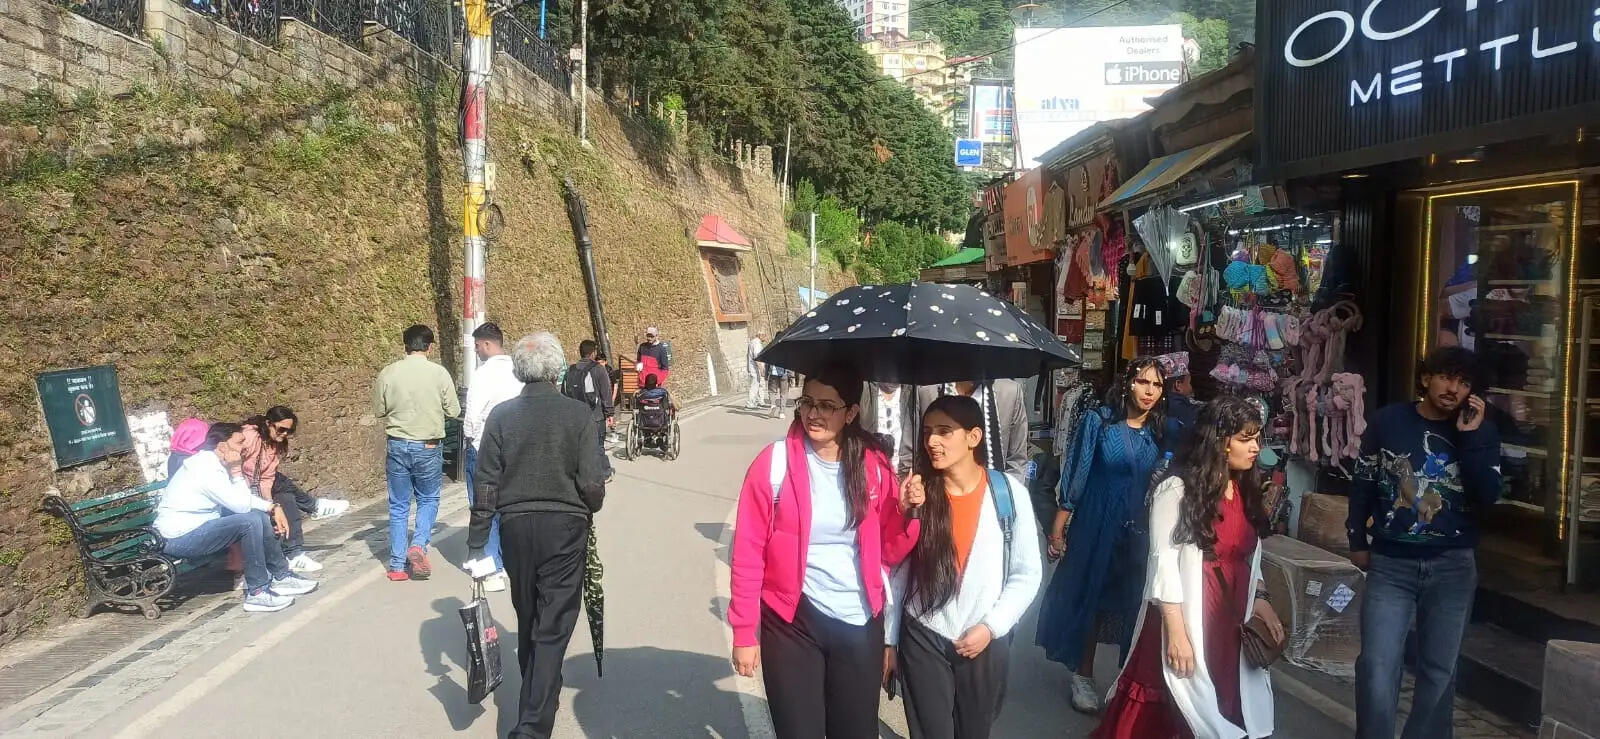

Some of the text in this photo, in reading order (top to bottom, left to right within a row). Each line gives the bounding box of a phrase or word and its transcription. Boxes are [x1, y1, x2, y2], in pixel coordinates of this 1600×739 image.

[1119, 35, 1168, 44] Authorised
[1284, 0, 1503, 67] OC
[1126, 47, 1161, 55] Dealers
[1351, 8, 1600, 107] METTL
[1125, 65, 1180, 81] iPhone
[960, 148, 980, 156] GLEN
